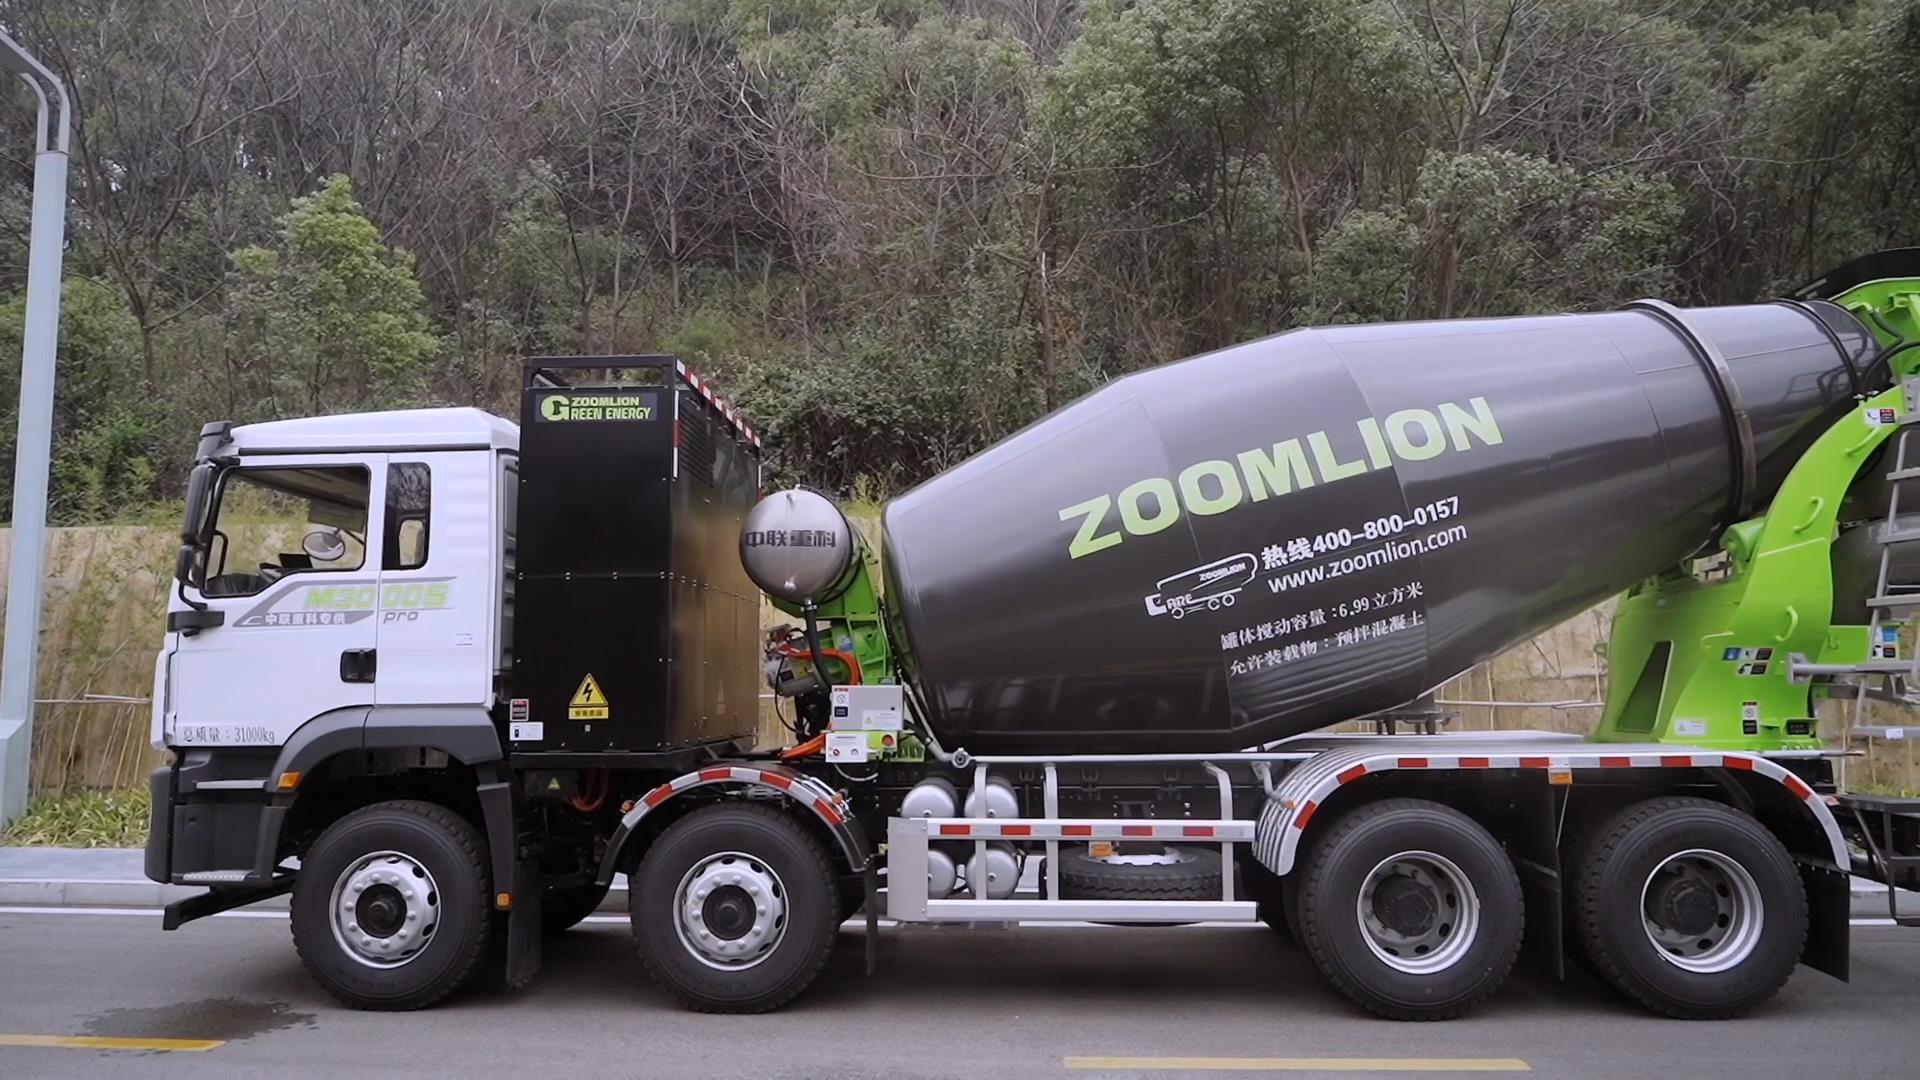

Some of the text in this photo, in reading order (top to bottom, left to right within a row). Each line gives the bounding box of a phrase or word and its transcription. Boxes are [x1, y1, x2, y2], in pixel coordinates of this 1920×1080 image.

[571, 397, 640, 407] ZOOMLION
[606, 407, 651, 420] ENERGY
[1058, 396, 1503, 559] ZOOMLION
[745, 530, 837, 547] 中联重科
[1268, 525, 1468, 594] www.zoomlion.com
[1199, 562, 1247, 581] ZOOMLION
[265, 613, 346, 626] 中联重科专供
[384, 611, 418, 624] pro
